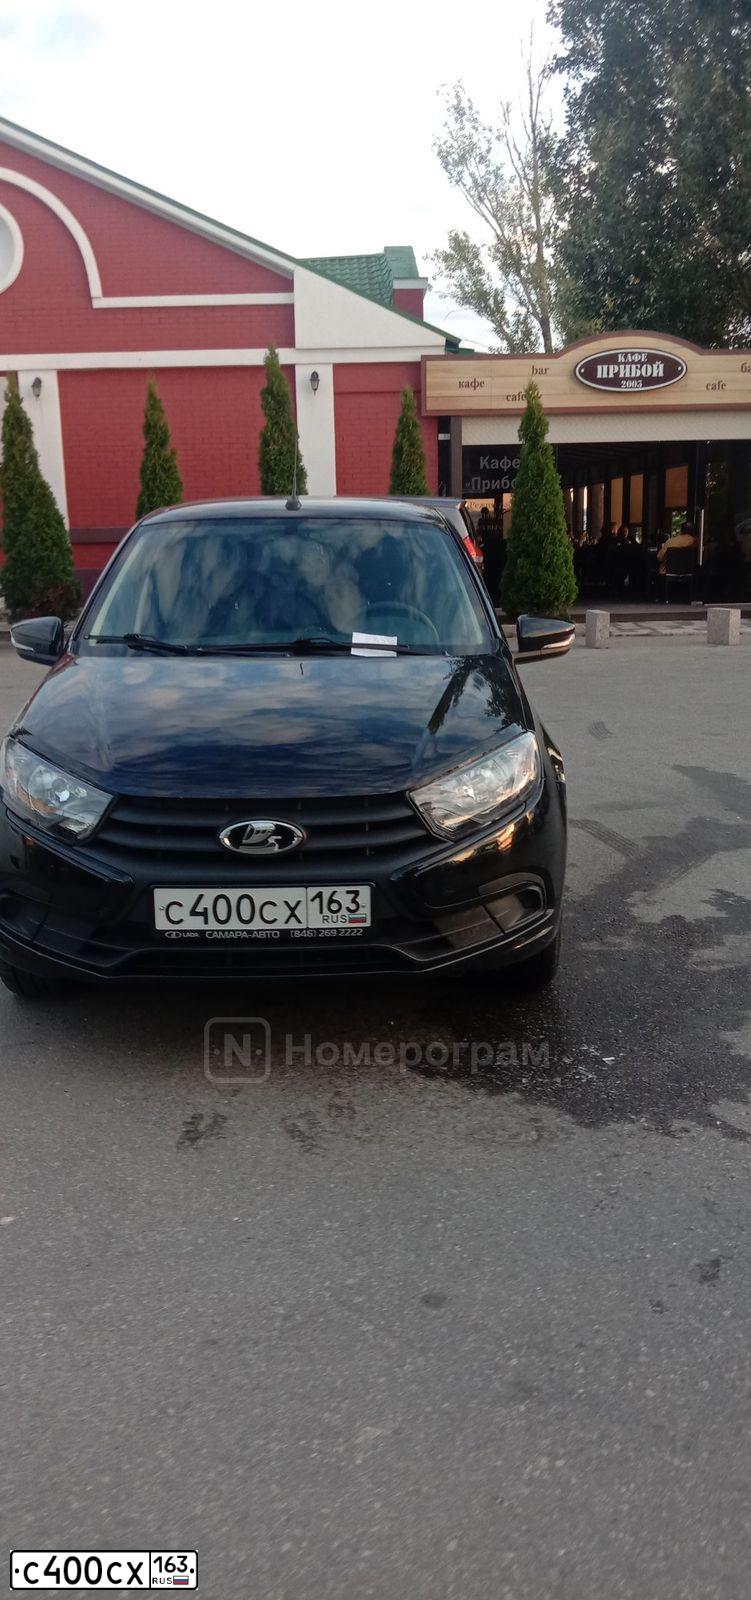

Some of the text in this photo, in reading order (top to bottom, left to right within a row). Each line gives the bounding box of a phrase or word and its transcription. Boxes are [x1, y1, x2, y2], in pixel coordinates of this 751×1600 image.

[617, 353, 648, 363] КАФЕ
[531, 365, 550, 375] bar
[596, 361, 665, 379] ПРИБОЙ
[458, 378, 485, 391] кафе
[705, 380, 727, 391] cafe
[479, 456, 521, 471] Кафе
[164, 889, 360, 926] С400СХ 163
[321, 914, 348, 925] RUS
[205, 928, 363, 939] САМАРА-АВТО (846) 269 2222
